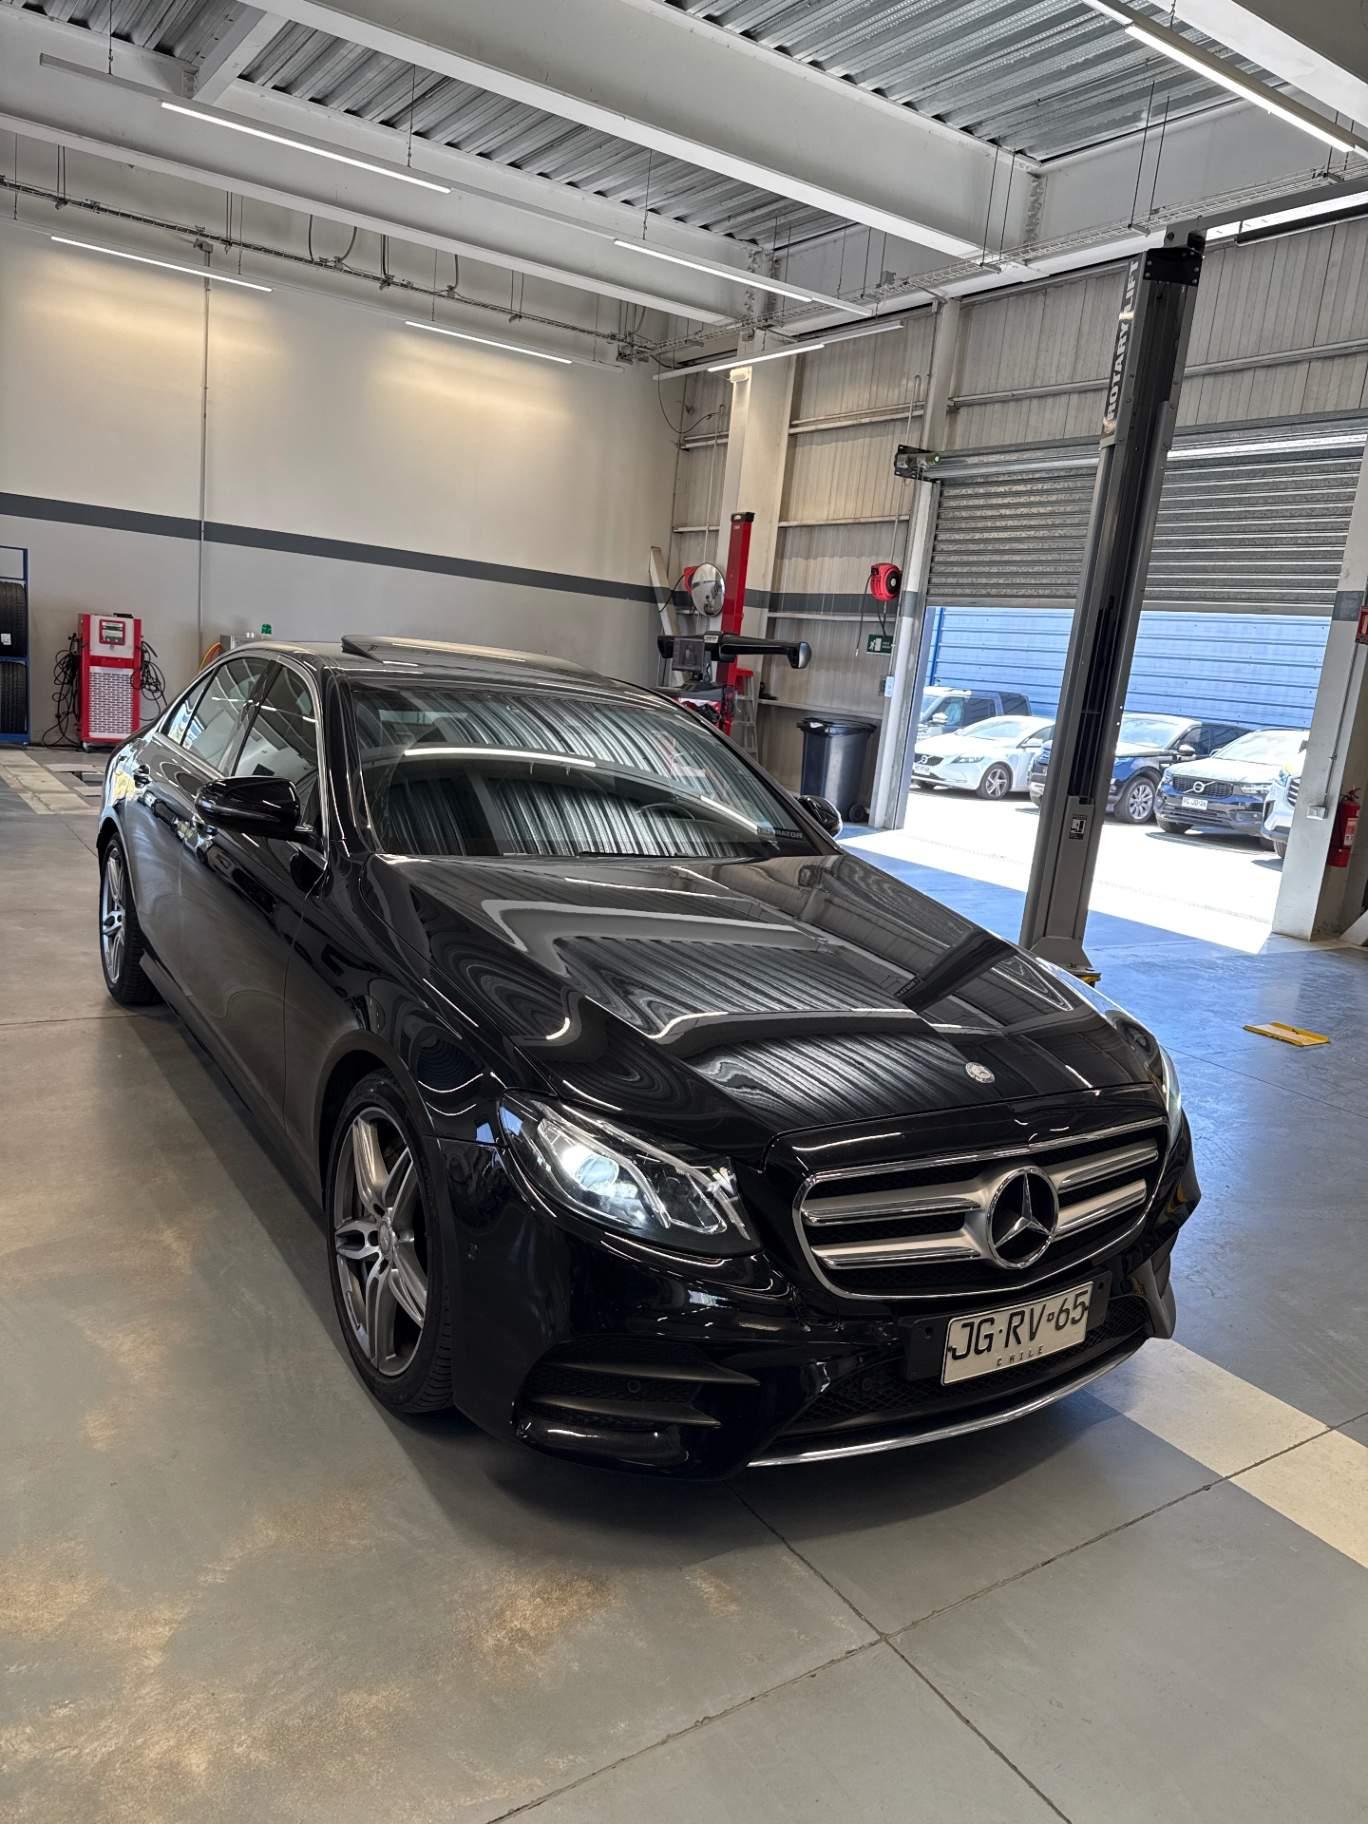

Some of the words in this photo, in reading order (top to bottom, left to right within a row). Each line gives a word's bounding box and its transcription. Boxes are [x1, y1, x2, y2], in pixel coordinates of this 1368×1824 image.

[1106, 322, 1129, 421] ROTARY
[1123, 260, 1139, 314] LIFT
[996, 1344, 1046, 1367] CHILE
